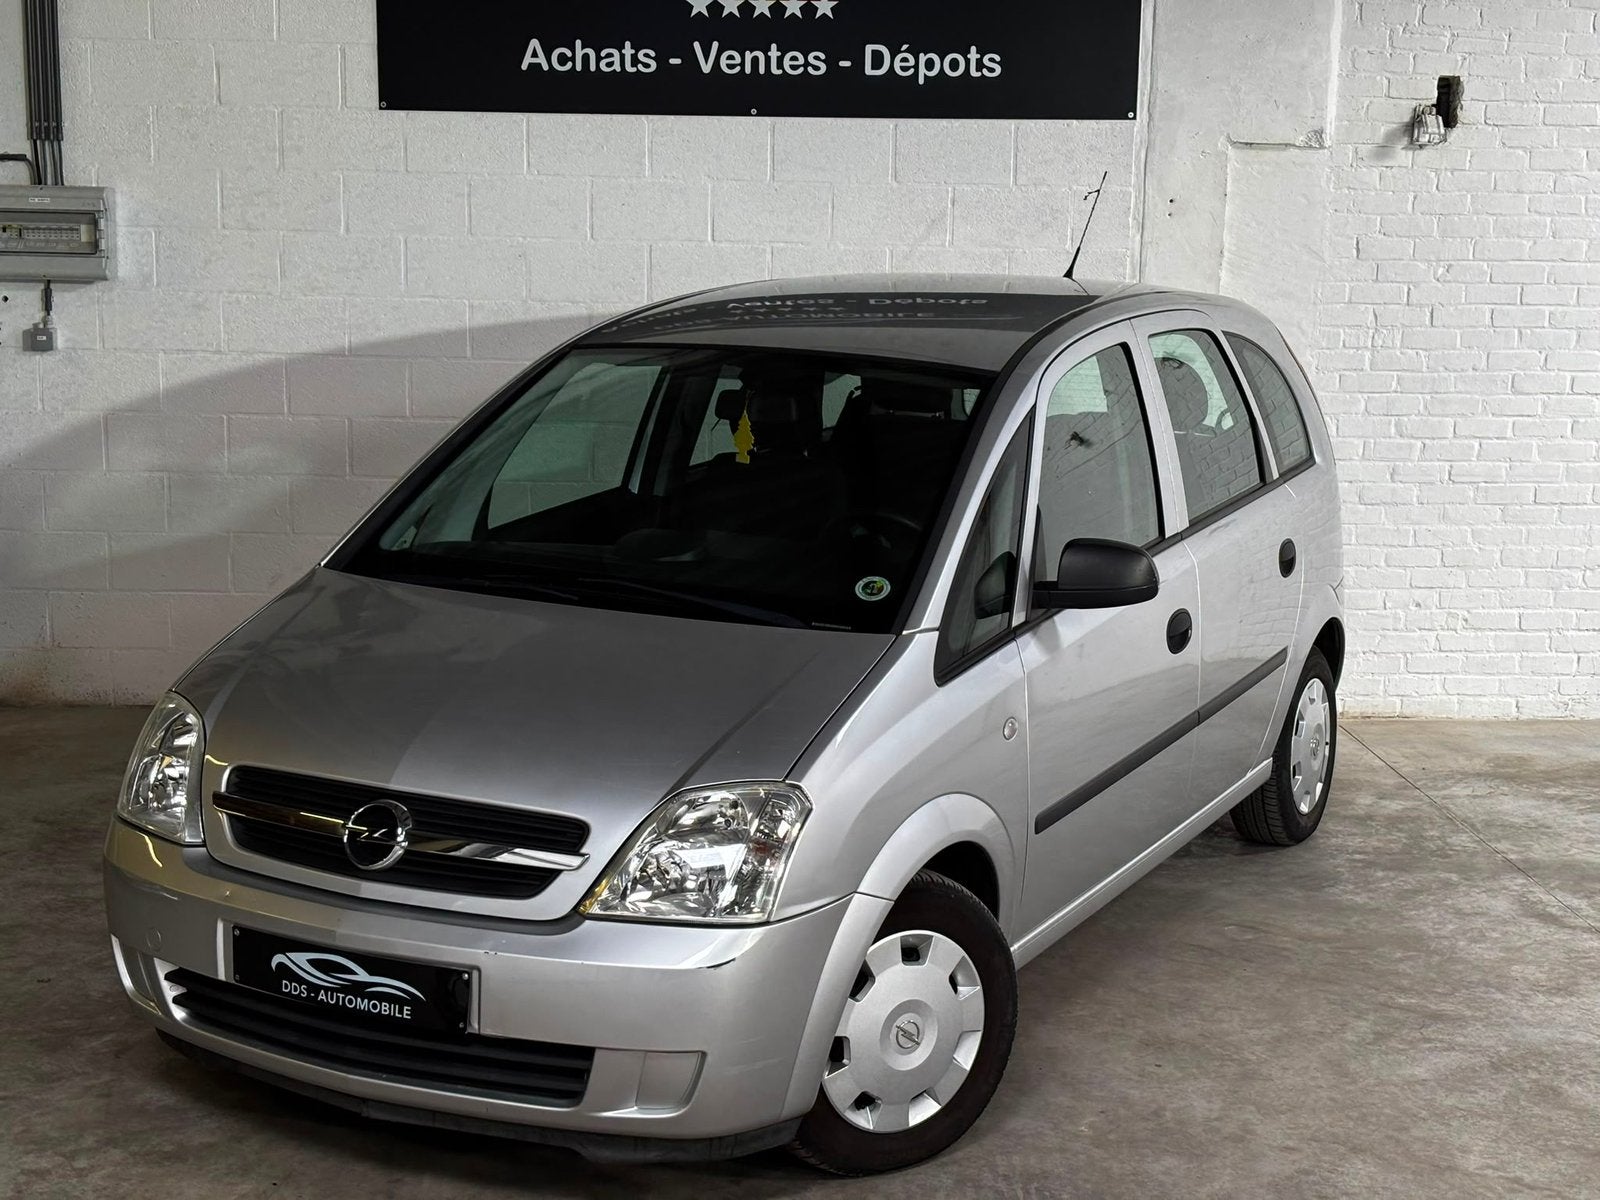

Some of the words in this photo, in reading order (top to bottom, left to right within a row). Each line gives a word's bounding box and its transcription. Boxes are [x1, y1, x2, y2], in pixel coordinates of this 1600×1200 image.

[520, 38, 657, 73] Achats
[693, 40, 827, 76] Ventes
[864, 43, 1002, 85] Dépots
[282, 979, 308, 998] DDS
[318, 989, 412, 1020] AUTOMOBILE
